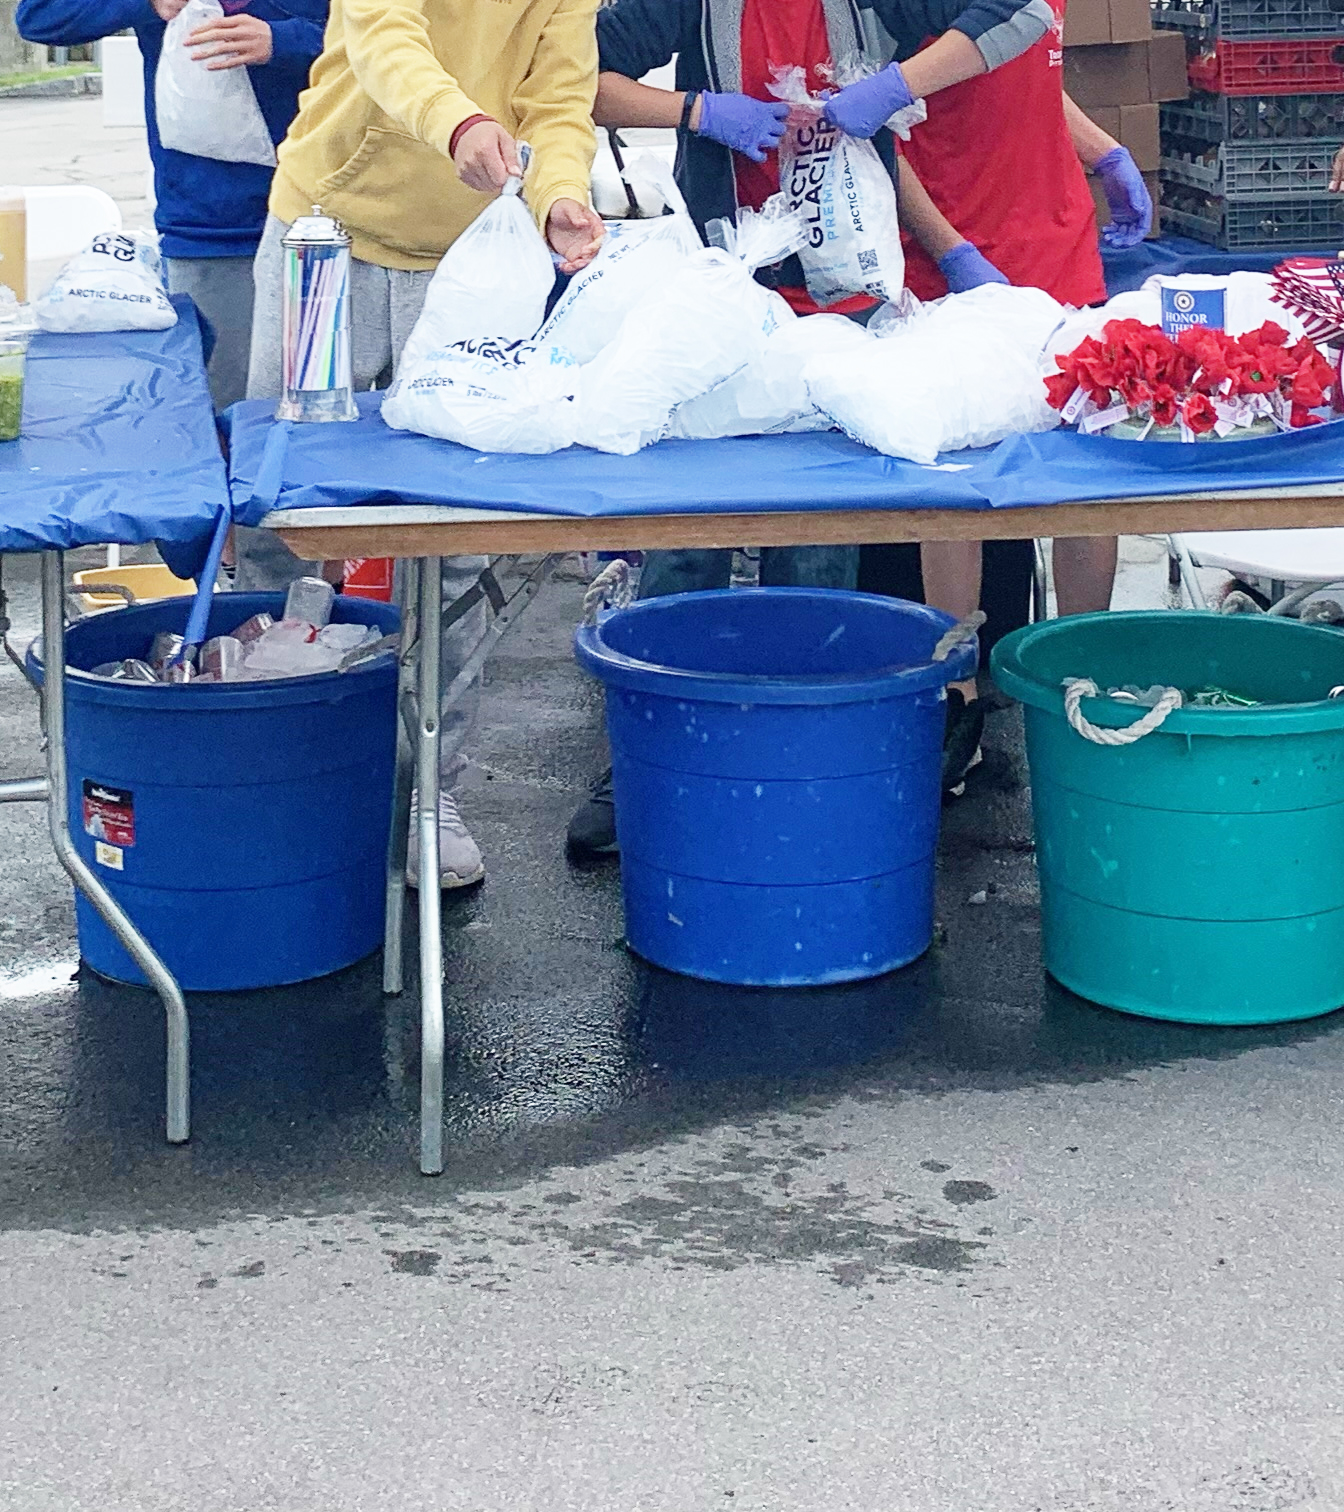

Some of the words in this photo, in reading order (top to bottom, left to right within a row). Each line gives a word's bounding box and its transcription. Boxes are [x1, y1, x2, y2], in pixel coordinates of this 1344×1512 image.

[789, 124, 816, 212] RCTIC
[847, 190, 864, 232] ARCTIC
[68, 289, 106, 299] ARCTIC
[109, 291, 152, 303] GLACIER
[1165, 311, 1208, 324] HONOR
